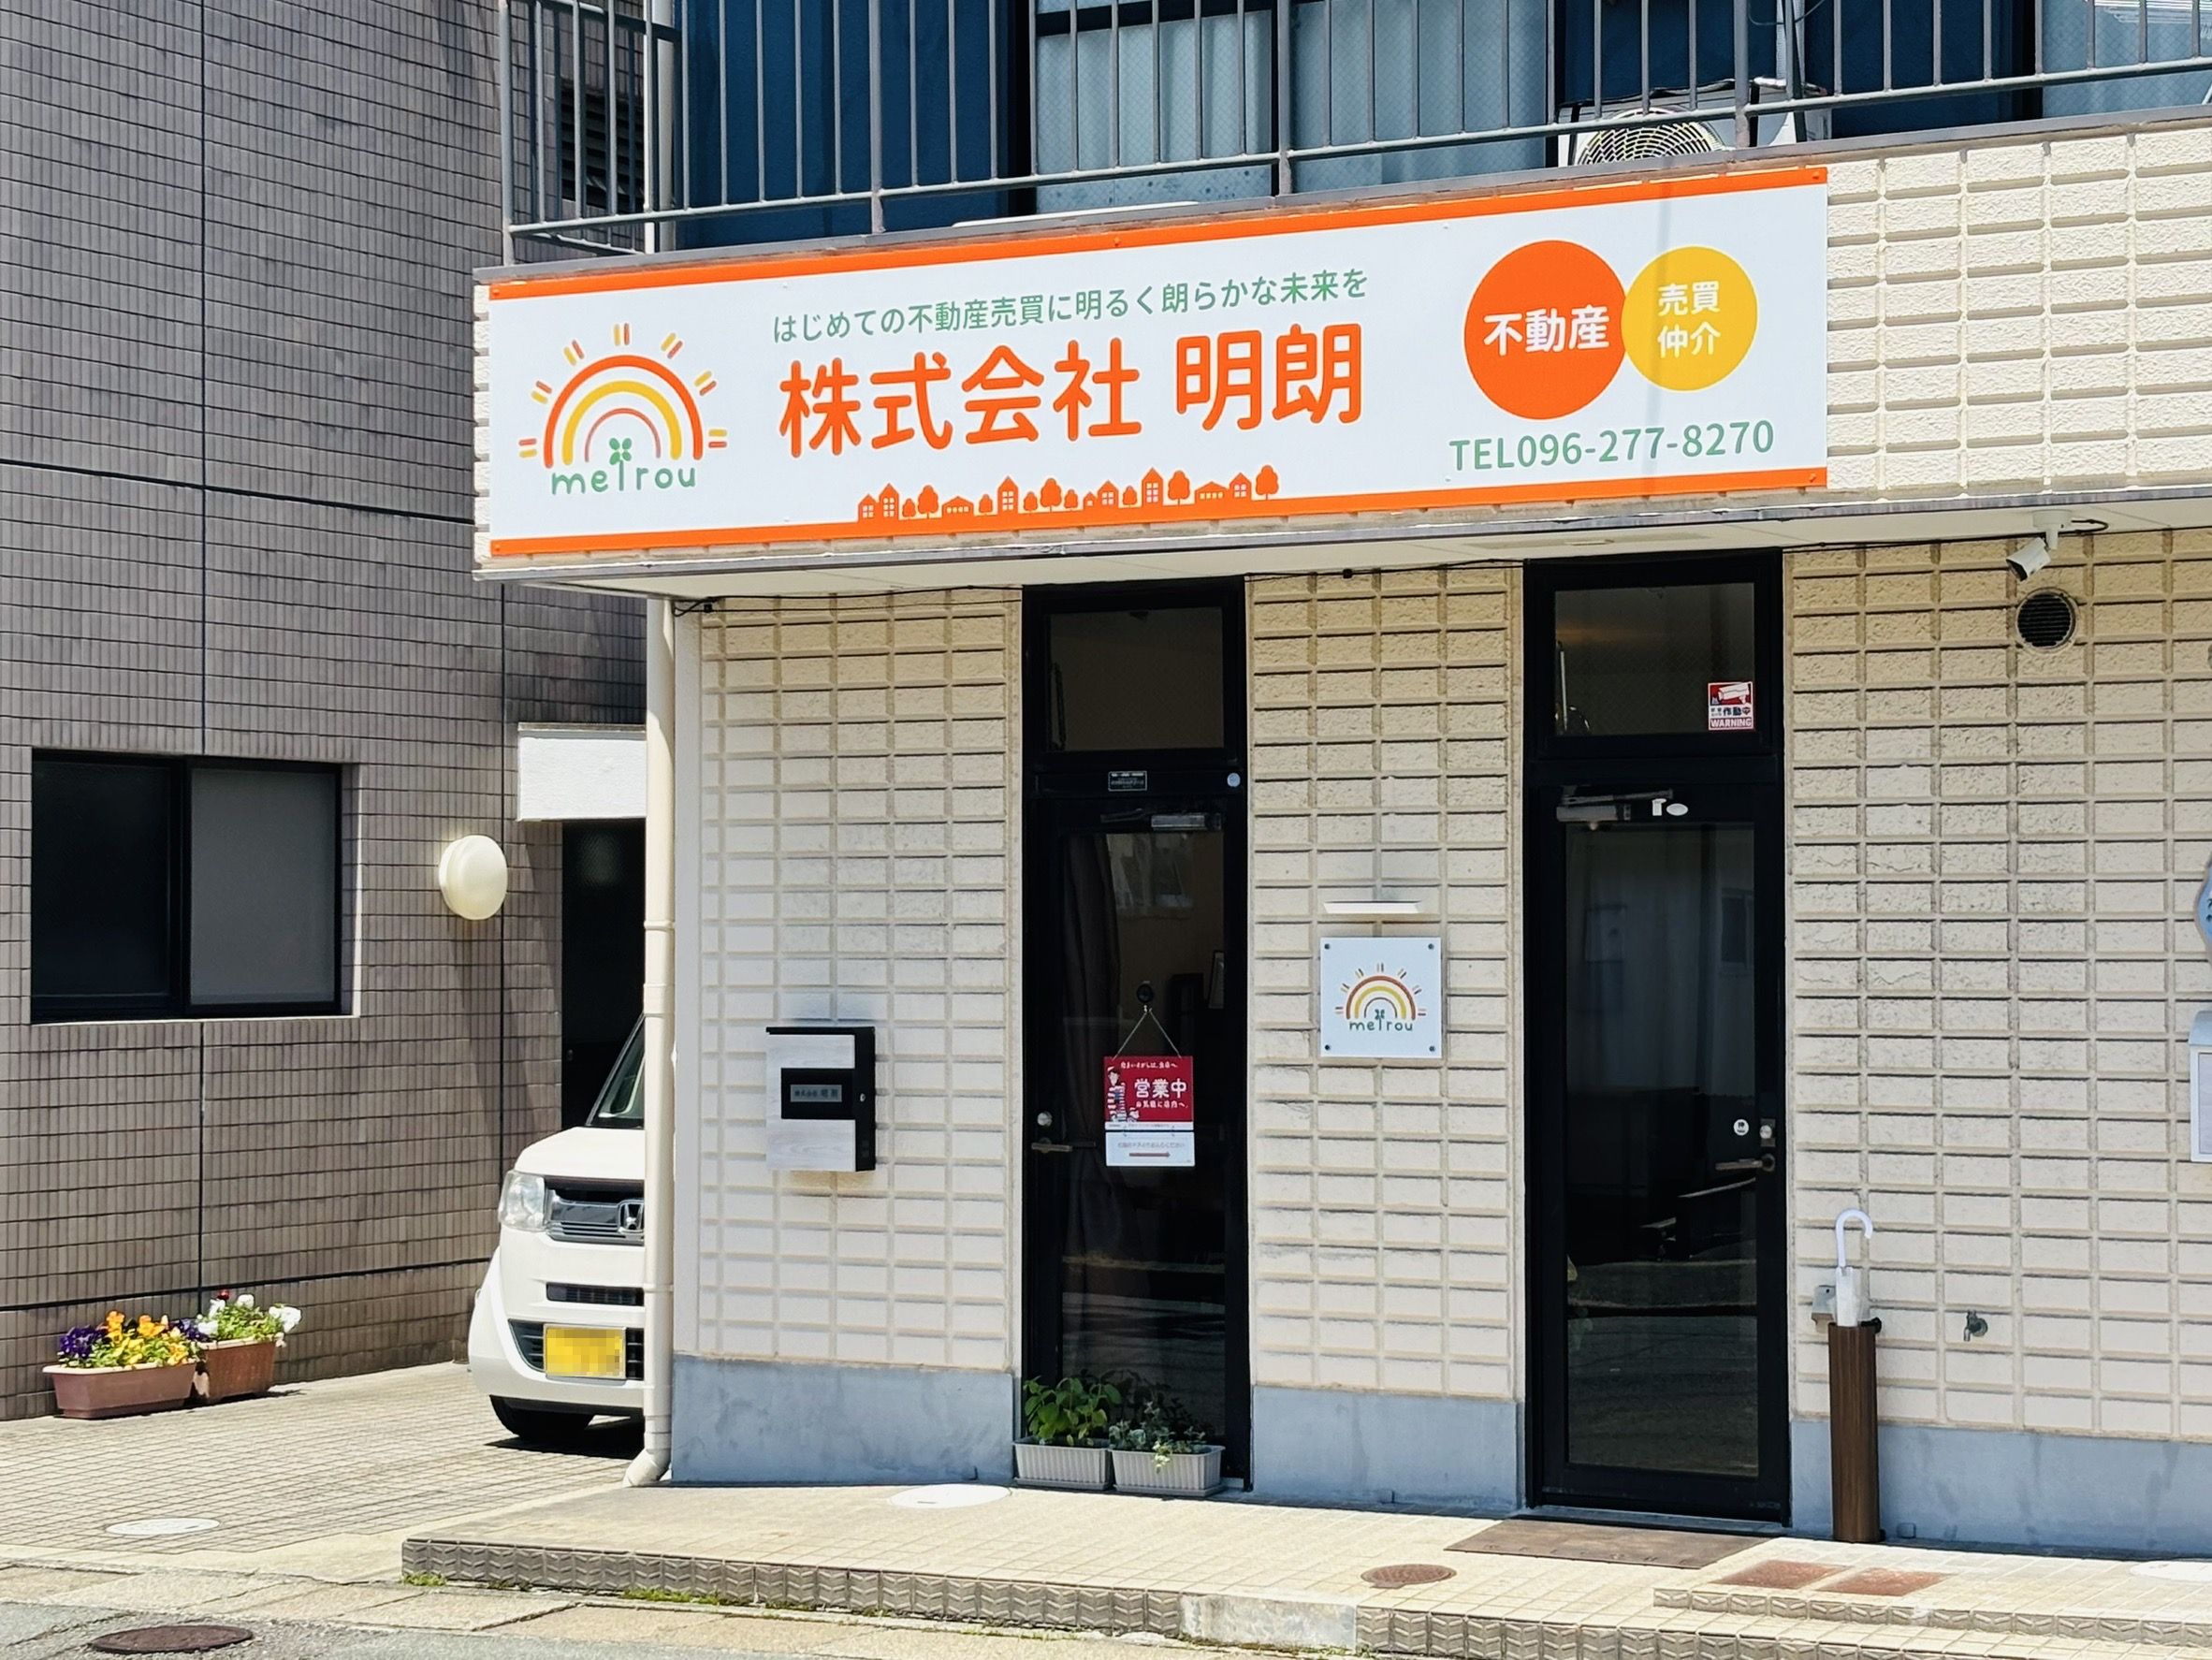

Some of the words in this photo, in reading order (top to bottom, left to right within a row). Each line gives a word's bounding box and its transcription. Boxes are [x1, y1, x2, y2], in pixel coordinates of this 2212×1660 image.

[773, 267, 1368, 343] はじめての不動産売買に明るく朗らかな未来を
[1657, 281, 1721, 316] 売買
[1483, 304, 1610, 357] 不動産
[1657, 321, 1721, 358] 仲介
[779, 337, 1142, 459] 株式会社
[1175, 322, 1362, 431] 明朗
[1448, 419, 1775, 472] TEL096-277-8270
[1710, 718, 1752, 728] WARNING
[1134, 1077, 1187, 1099] 営業中
